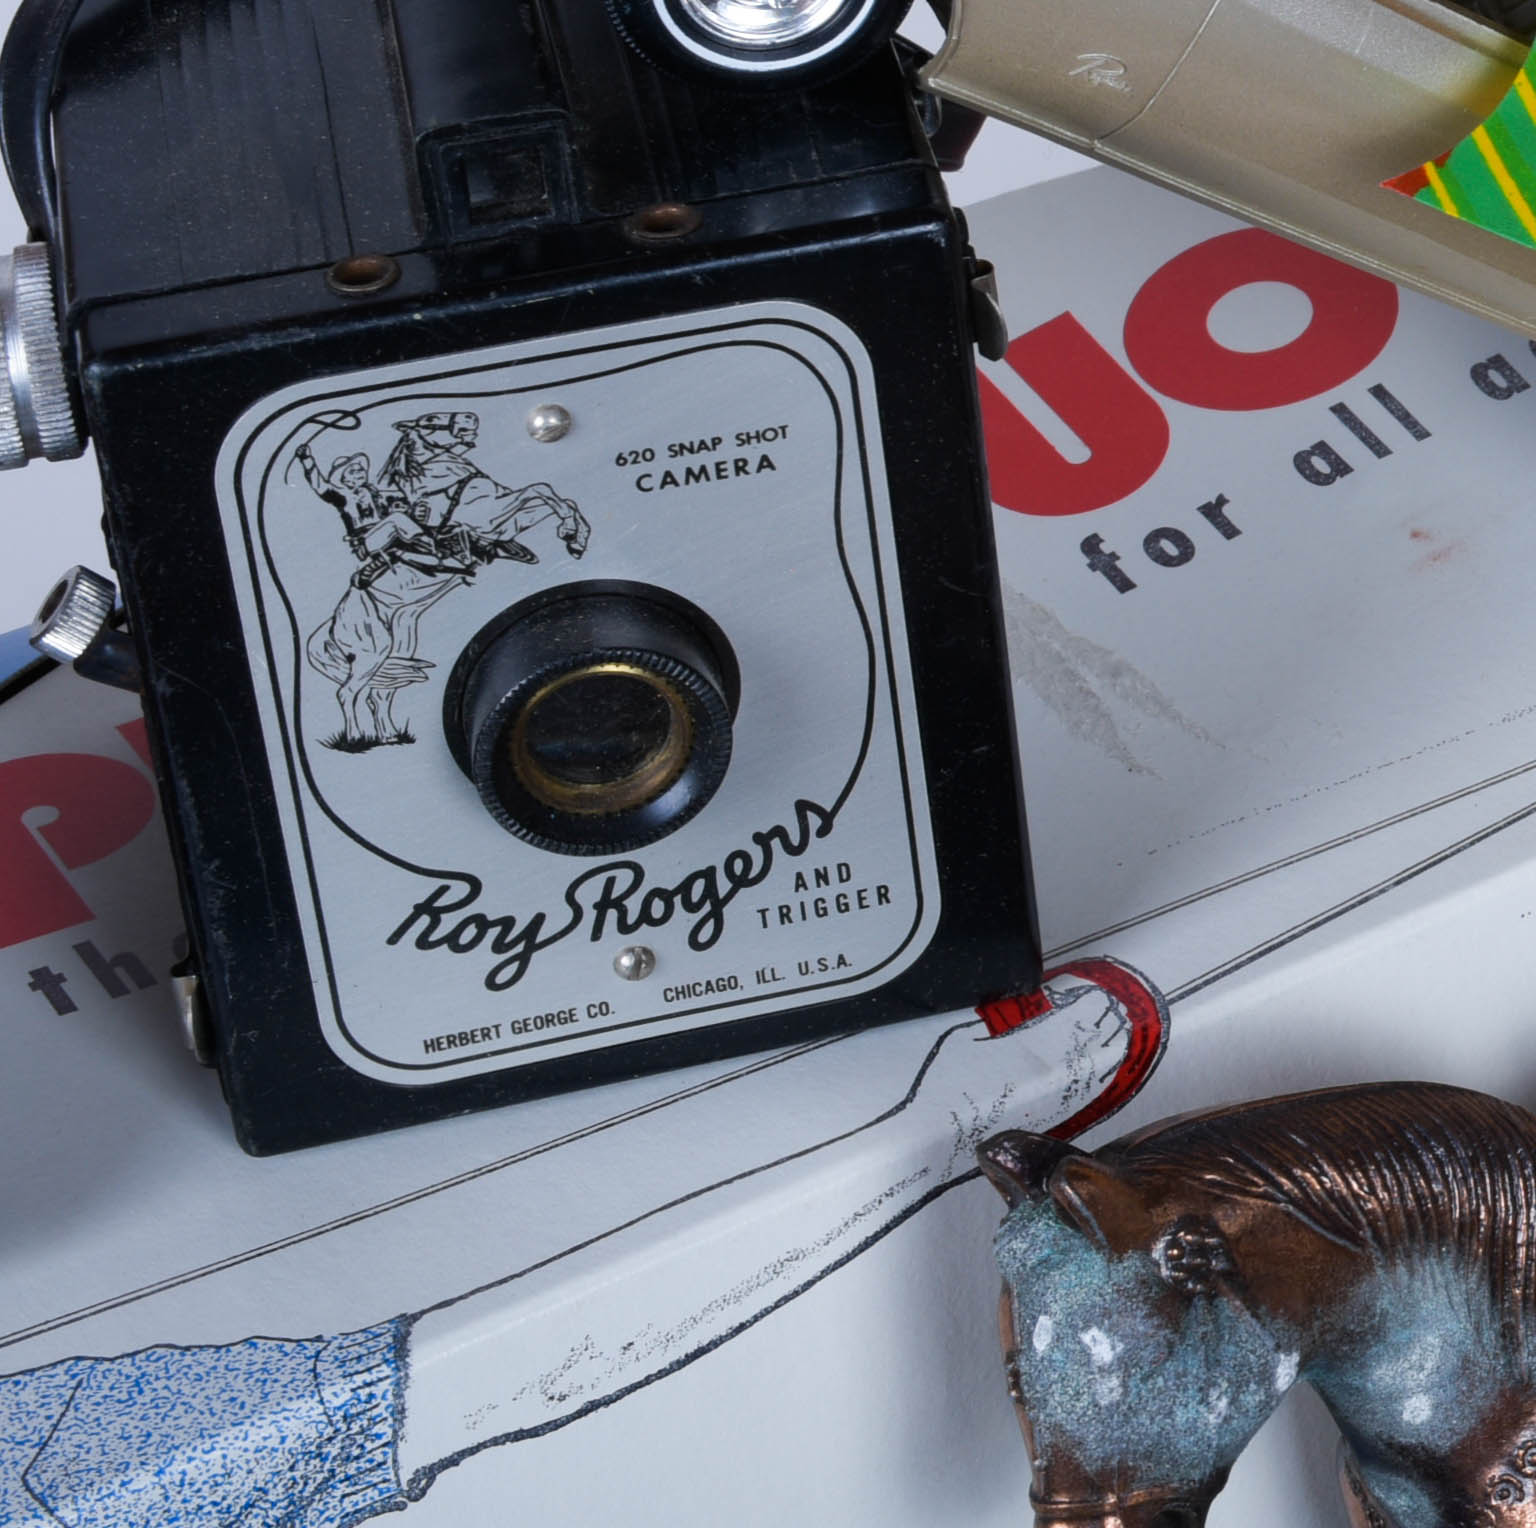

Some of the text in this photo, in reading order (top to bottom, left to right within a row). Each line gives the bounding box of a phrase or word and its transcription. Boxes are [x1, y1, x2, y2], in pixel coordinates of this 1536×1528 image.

[614, 424, 789, 467] 620 SNAP SHOT
[635, 453, 776, 493] CAMERA
[28, 930, 190, 1016] th
[1079, 492, 1243, 594] for
[1292, 382, 1433, 486] all
[386, 798, 835, 992] Roy Rogers
[793, 861, 853, 893] AND
[756, 883, 893, 929] TRIGGER
[662, 953, 853, 1004] CHICAGO, ILL. U.S.A.
[422, 1000, 616, 1054] HERBERT GEORGE CO.
